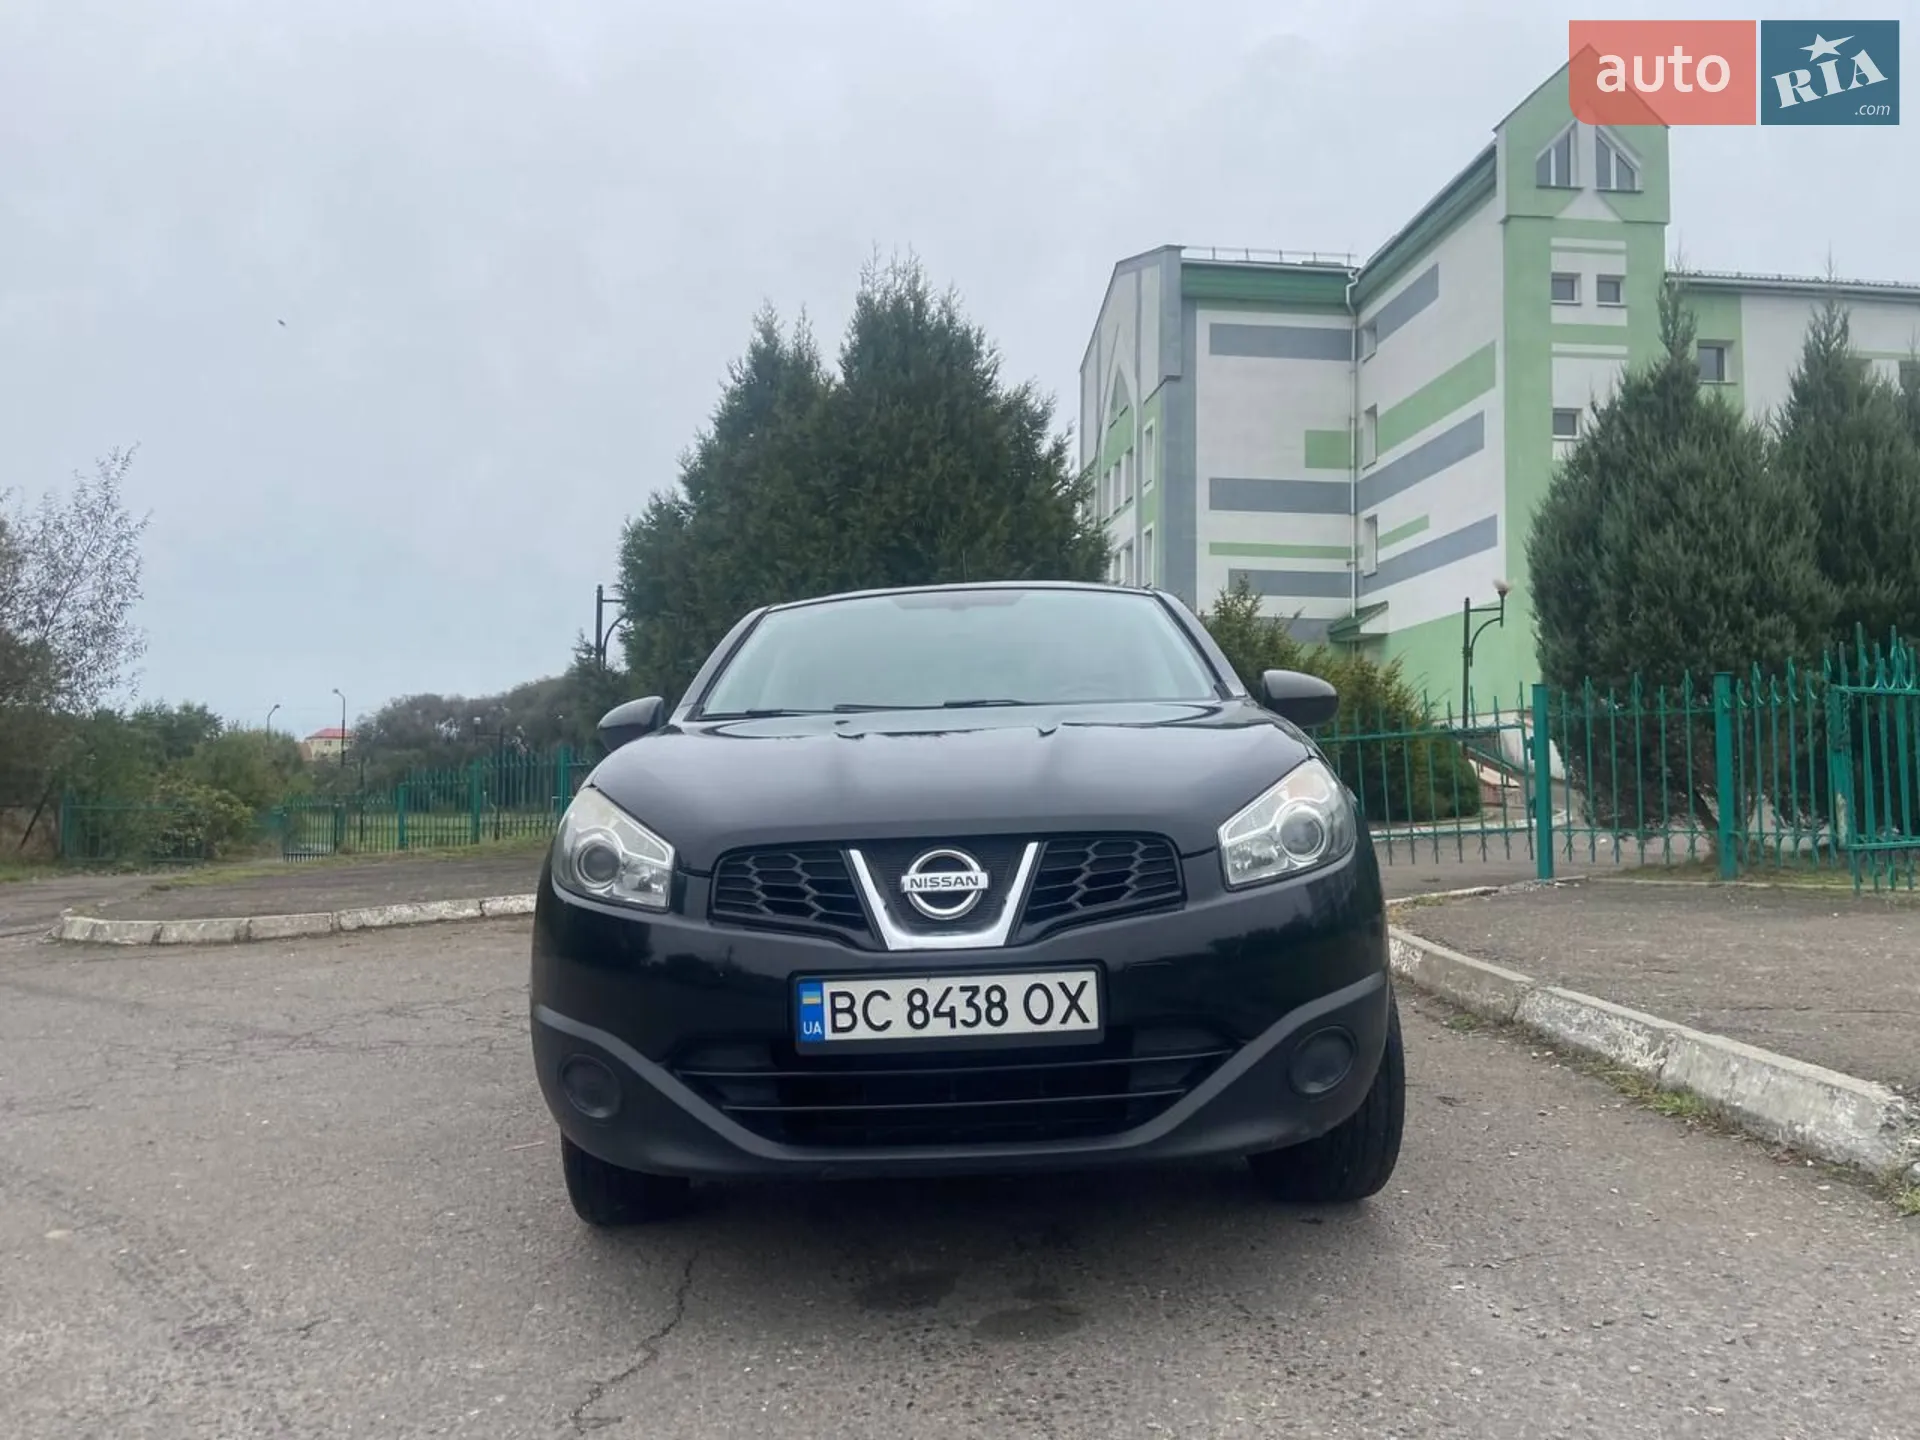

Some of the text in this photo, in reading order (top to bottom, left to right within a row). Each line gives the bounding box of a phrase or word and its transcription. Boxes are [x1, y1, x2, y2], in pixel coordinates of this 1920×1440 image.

[909, 875, 980, 889] NISSAN
[829, 980, 1091, 1034] BC 8438 OX
[803, 1021, 823, 1036] UA
